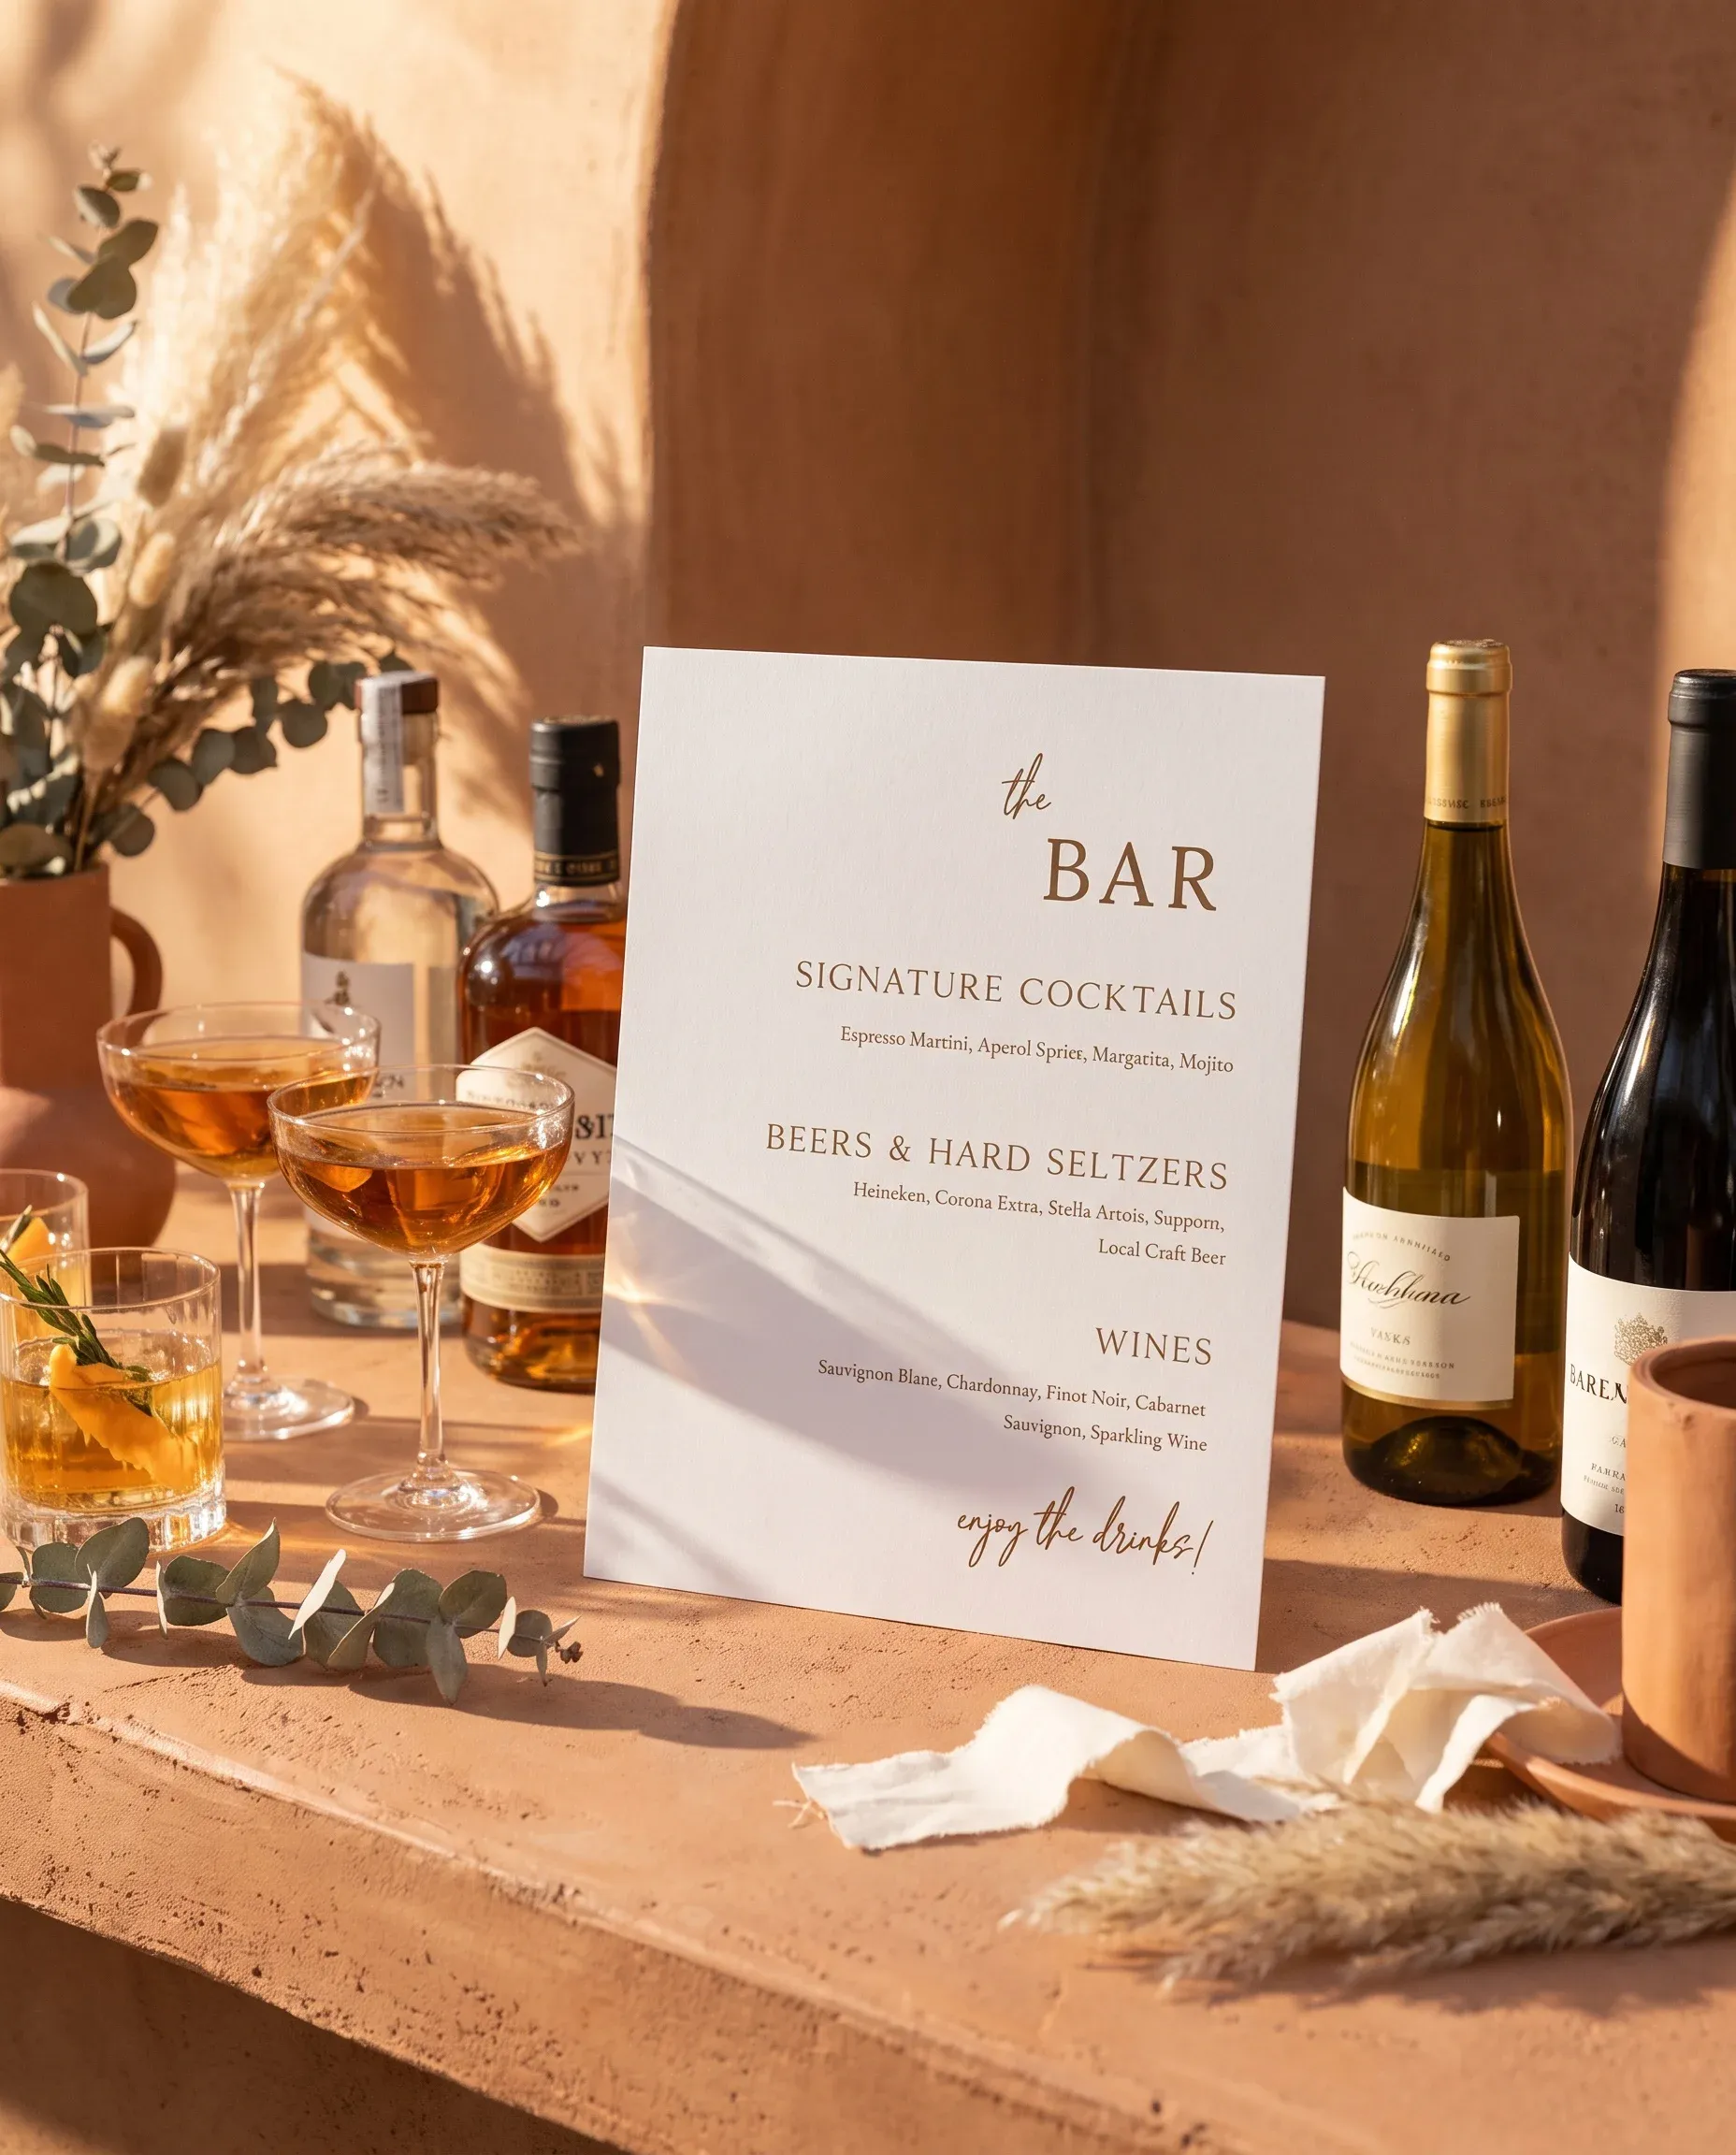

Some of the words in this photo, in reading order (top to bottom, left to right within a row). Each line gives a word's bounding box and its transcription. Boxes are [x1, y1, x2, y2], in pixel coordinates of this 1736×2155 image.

[1002, 753, 1051, 819] the
[1043, 838, 1216, 911] BAR
[797, 961, 1002, 1002] SIGNATURE
[1020, 978, 1236, 1020] COCKTAILS
[841, 1026, 905, 1048] Espresso
[909, 1032, 972, 1054] Martini,
[977, 1037, 1031, 1059] Aperol
[1179, 1053, 1233, 1076] Mojito
[766, 1123, 871, 1158] BEERS
[890, 1135, 911, 1162] &
[929, 1137, 1030, 1171] HARD
[1048, 1149, 1226, 1190] SELTZERS
[853, 1181, 930, 1206] Heineken,
[935, 1190, 992, 1209] Corona
[998, 1195, 1042, 1216] Extra,
[1096, 1205, 1149, 1225] Artois,
[1154, 1210, 1224, 1233] Supporn,
[1098, 1238, 1139, 1257] Local
[1145, 1243, 1186, 1261] Craft
[1191, 1247, 1226, 1265] Beer
[1095, 1327, 1211, 1365] WINES
[818, 1360, 893, 1383] Sauvignon
[898, 1368, 942, 1390] Blane,
[948, 1374, 1041, 1402] Chardonnay,
[1047, 1385, 1087, 1403] Finot
[1092, 1390, 1130, 1410] Noir,
[1136, 1395, 1206, 1416] Cabarnet
[1004, 1414, 1085, 1440] Sauvignon,
[1091, 1425, 1163, 1452] Sparkling
[1167, 1433, 1207, 1451] Wine
[958, 1514, 1029, 1568] enjoy
[1034, 1486, 1083, 1550] the
[1092, 1496, 1214, 1575] drinks!
